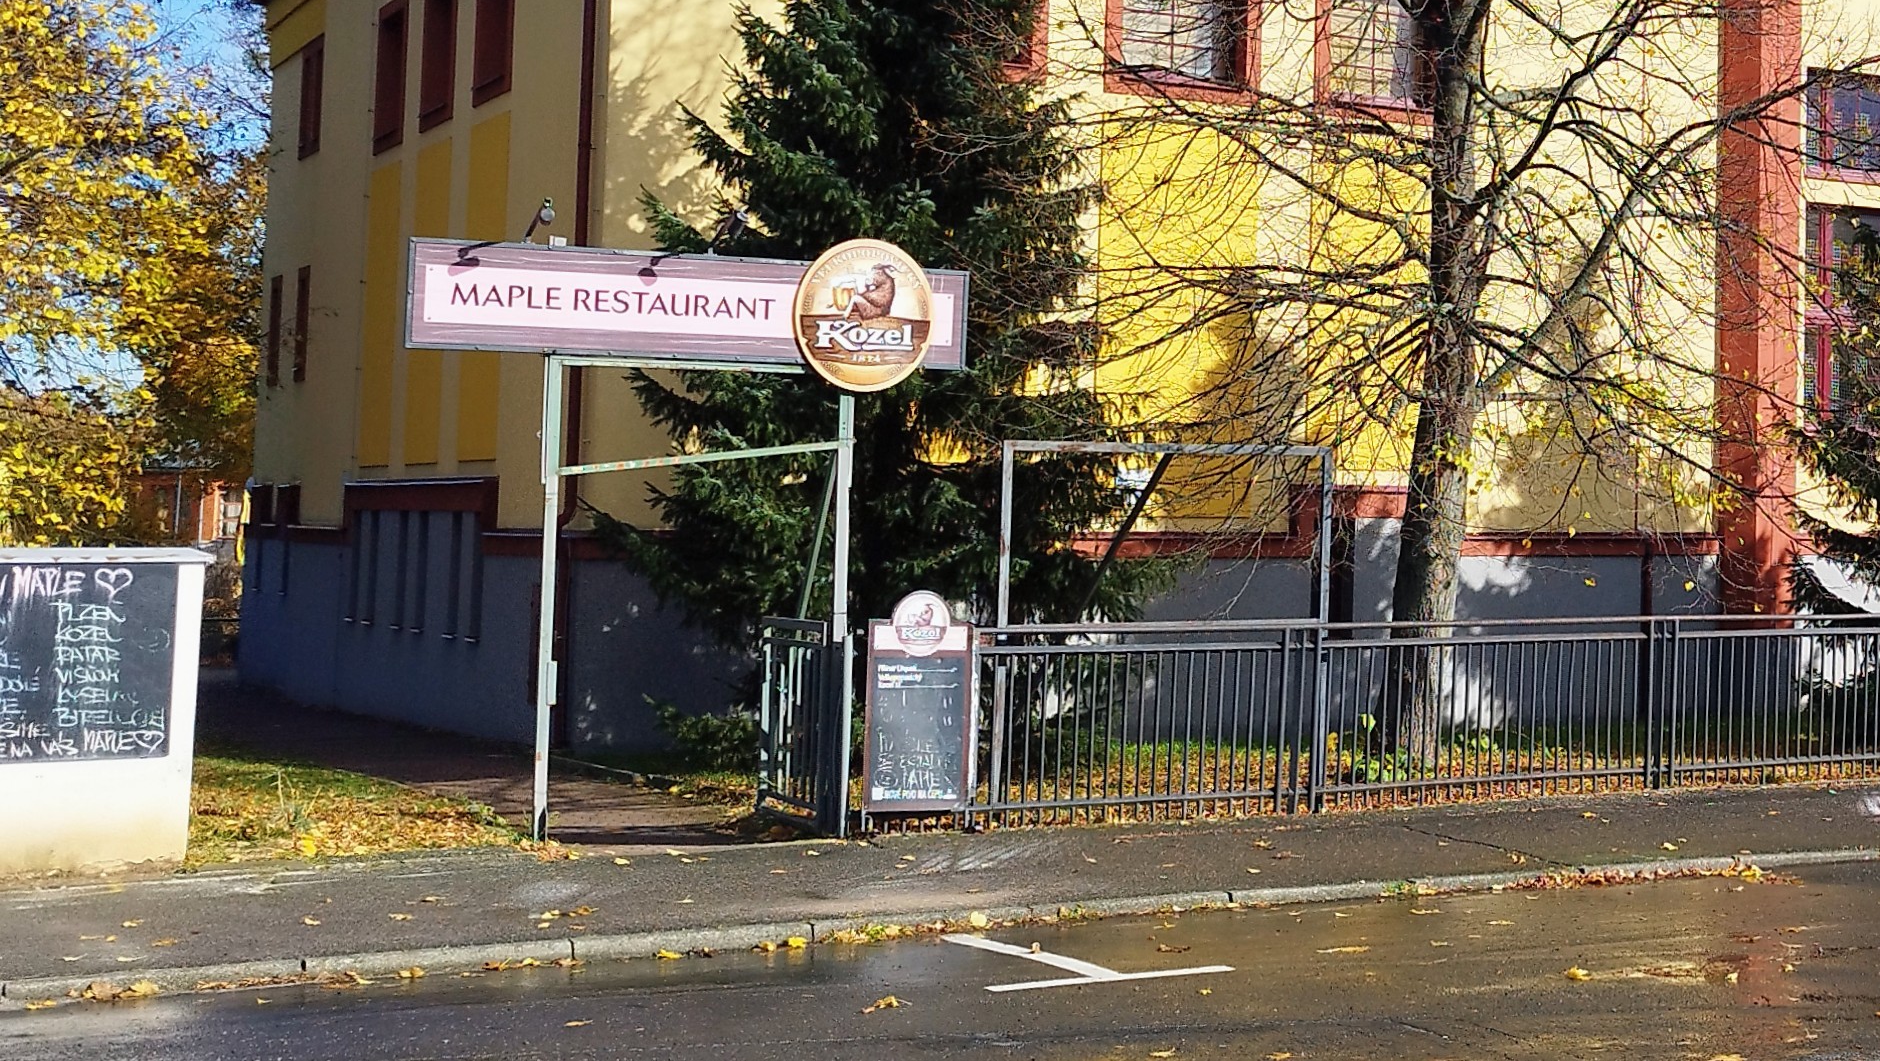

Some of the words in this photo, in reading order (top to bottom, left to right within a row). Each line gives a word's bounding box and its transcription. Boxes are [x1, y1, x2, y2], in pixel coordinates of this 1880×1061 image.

[450, 282, 562, 310] MAPLE
[573, 288, 776, 321] RESTAURANT
[814, 320, 914, 351] Kozel
[12, 566, 86, 598] MAPLE
[55, 624, 124, 642] KOZEL
[11, 740, 33, 757] NA
